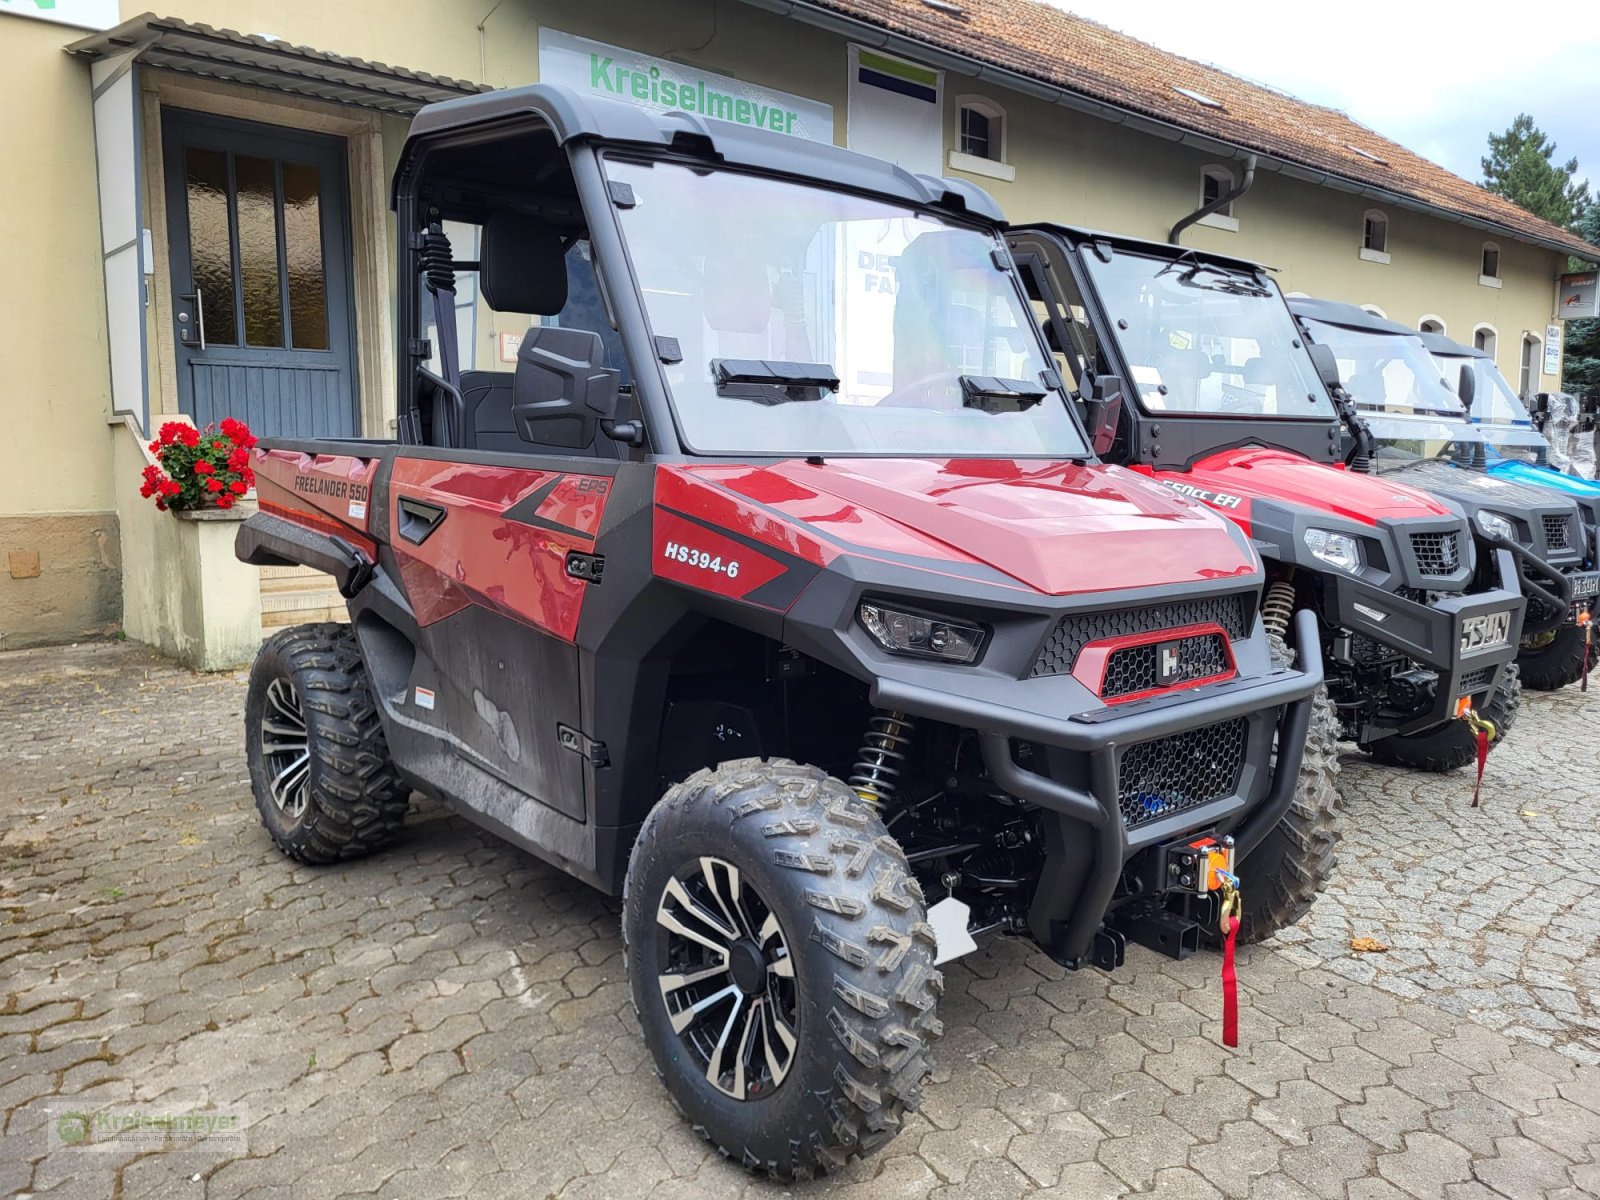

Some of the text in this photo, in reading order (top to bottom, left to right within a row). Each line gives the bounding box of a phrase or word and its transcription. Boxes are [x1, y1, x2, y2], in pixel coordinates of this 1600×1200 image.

[294, 475, 368, 502] FREELANDER 550
[578, 479, 609, 495] EPS
[1213, 493, 1242, 509] EFI
[664, 541, 740, 578] HS394-6
